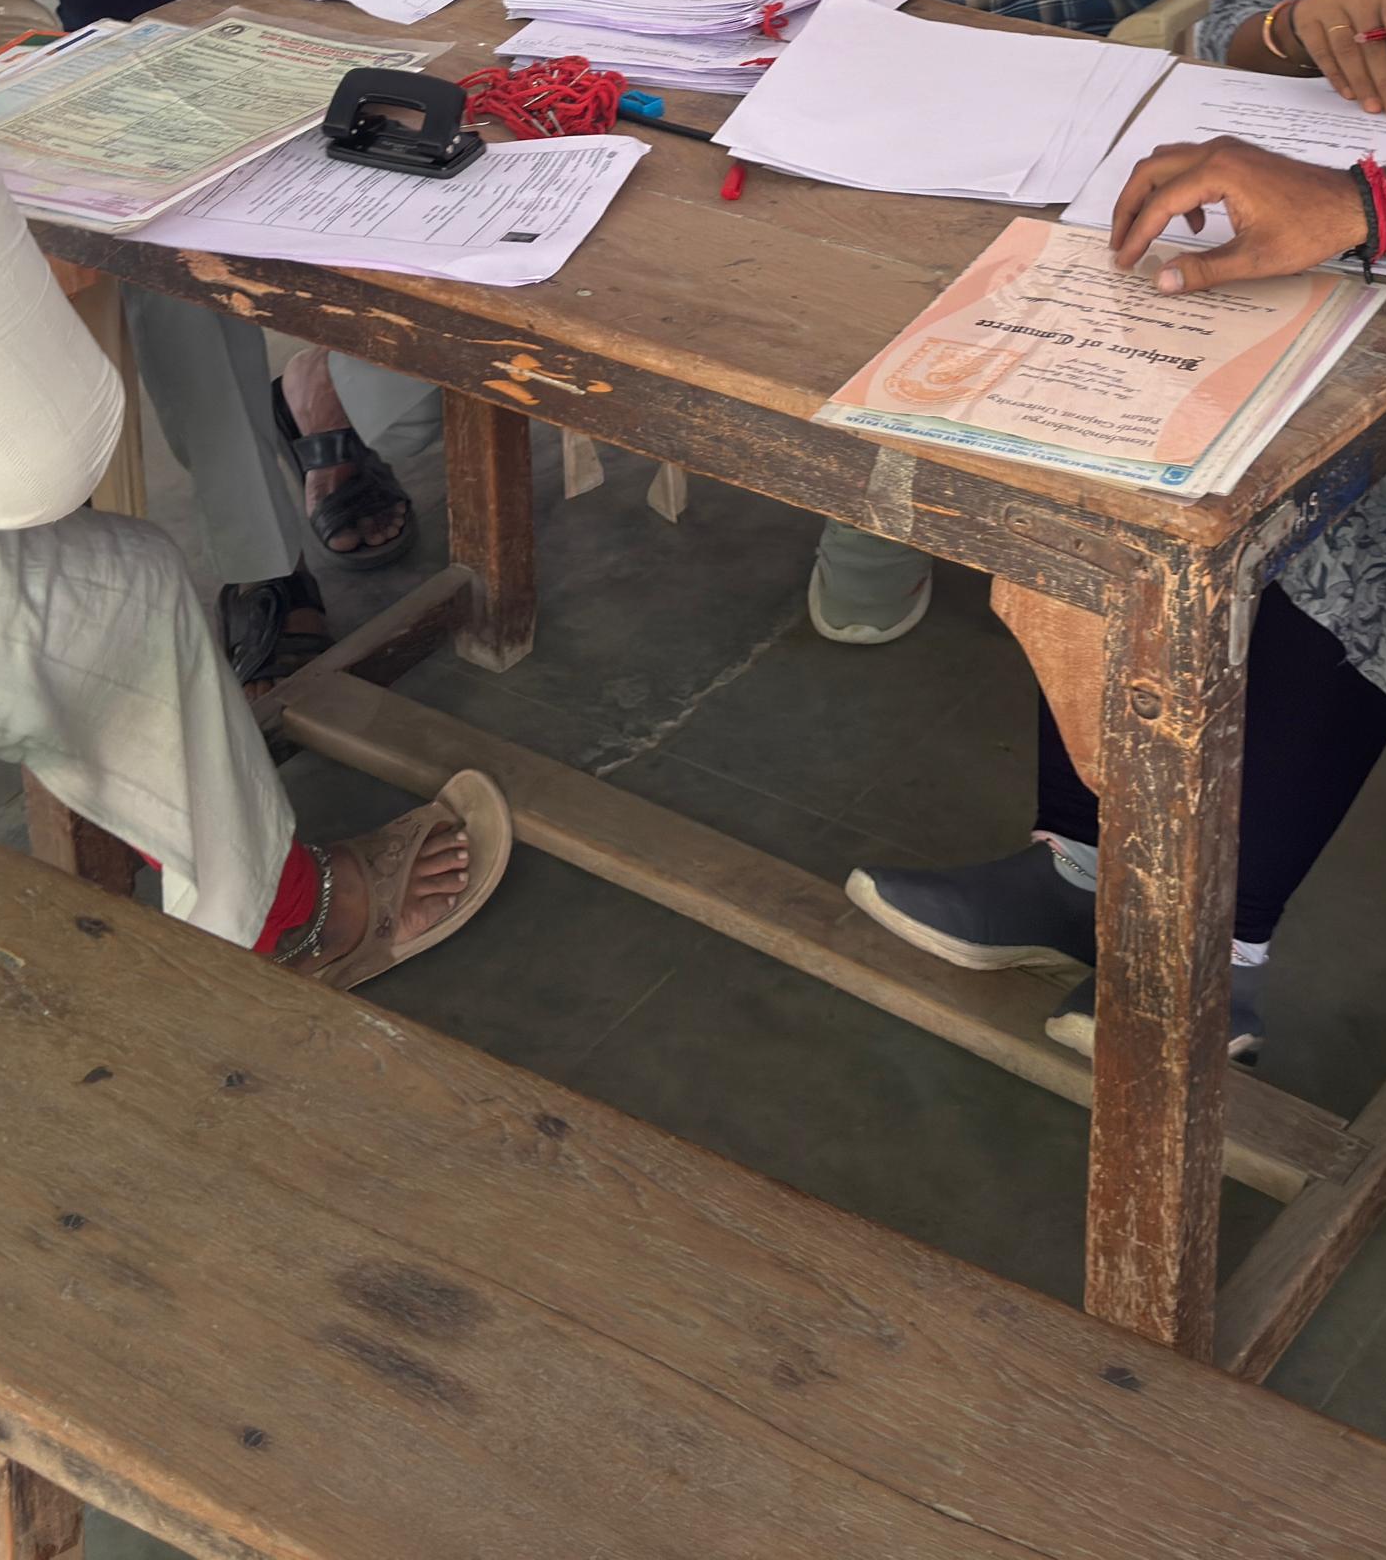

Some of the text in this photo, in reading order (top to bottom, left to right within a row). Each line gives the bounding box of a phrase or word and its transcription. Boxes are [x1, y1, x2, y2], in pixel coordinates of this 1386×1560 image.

[974, 319, 1204, 371] Bachelor of Commerce
[986, 393, 1159, 435] North Gujarat University
[1121, 413, 1162, 425] Patan
